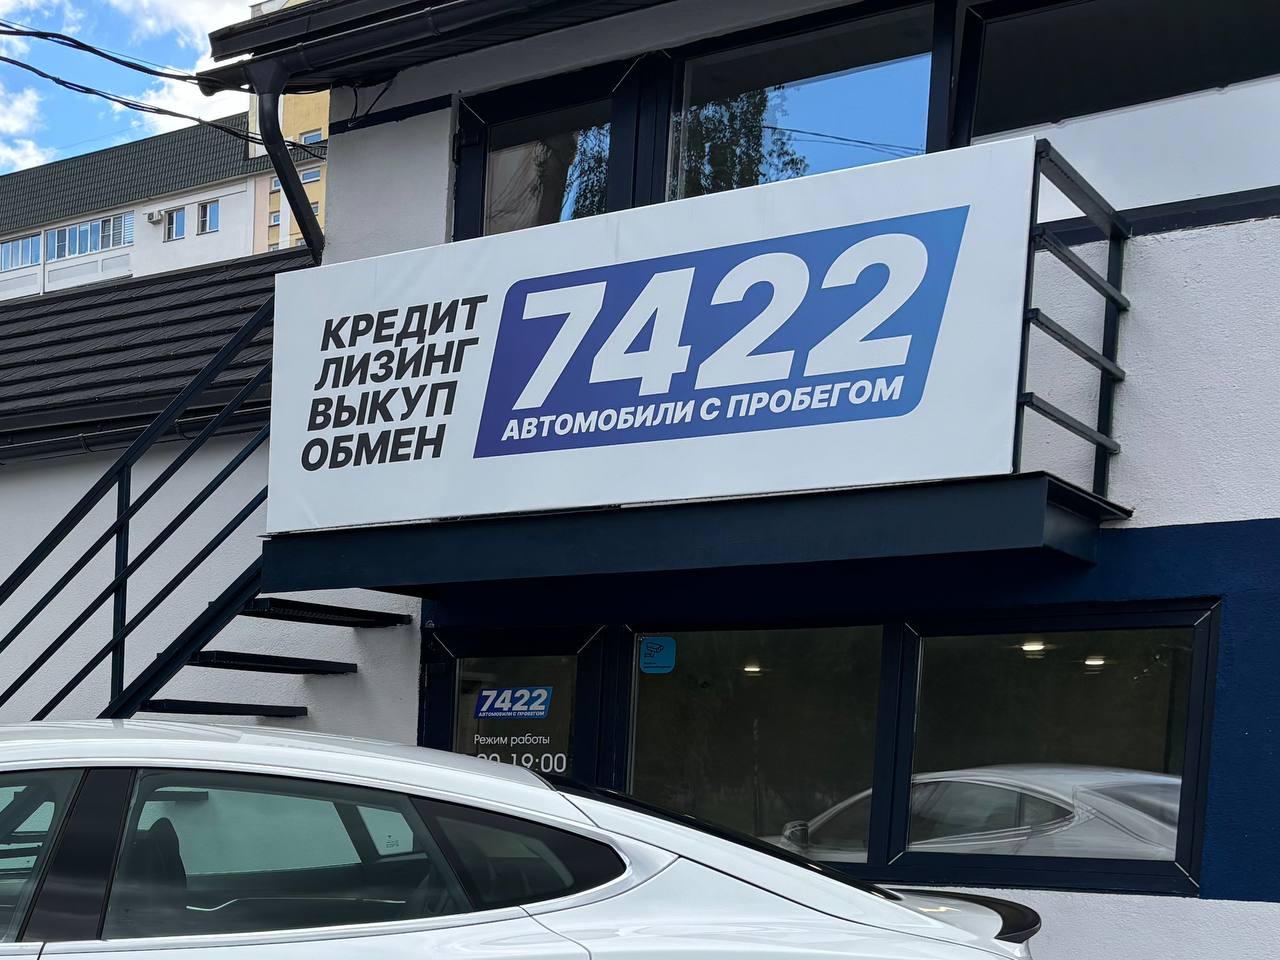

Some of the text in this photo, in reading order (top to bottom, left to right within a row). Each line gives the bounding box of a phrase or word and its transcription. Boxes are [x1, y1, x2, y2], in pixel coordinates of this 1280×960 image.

[320, 294, 489, 352] КРЕДИТ
[512, 233, 929, 411] 7422
[313, 337, 480, 391] ЛИЗИНГ
[307, 380, 458, 431] ВЫКУП
[500, 375, 905, 442] АВТОМОБИЛИ С ПРОБЕГОМ
[301, 424, 447, 472] ОБМЕН
[480, 688, 548, 712] 7422
[473, 733, 550, 747] Режим работы
